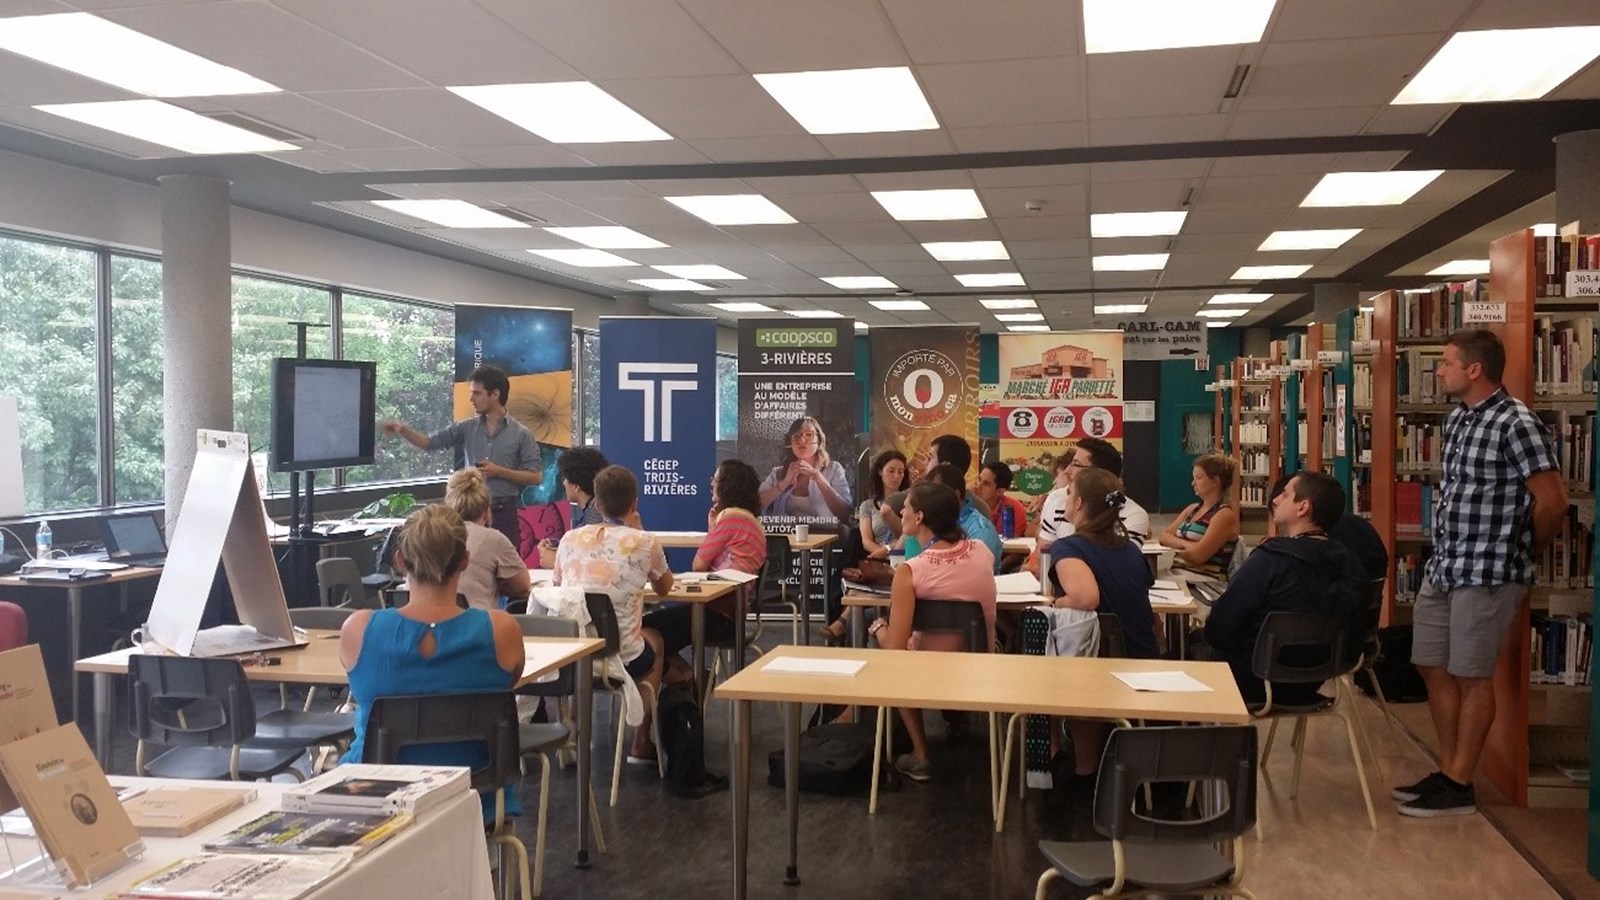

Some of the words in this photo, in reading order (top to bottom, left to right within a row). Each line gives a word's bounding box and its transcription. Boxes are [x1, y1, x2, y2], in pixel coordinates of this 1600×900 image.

[761, 350, 832, 365] 3-RIVIÈRES
[754, 382, 773, 390] UNE
[775, 382, 832, 391] ENTREPRISE
[1049, 378, 1071, 394] IGA
[1071, 380, 1115, 393] PAQUETTE
[754, 392, 767, 400] AU
[754, 402, 807, 410] D'AFFAIRES
[644, 458, 679, 470] CÉGEP
[644, 472, 684, 482] TROIS-
[644, 483, 697, 495] RIVIÈRES
[798, 516, 838, 524] MEMBRE
[764, 524, 791, 533] LUTÔT
